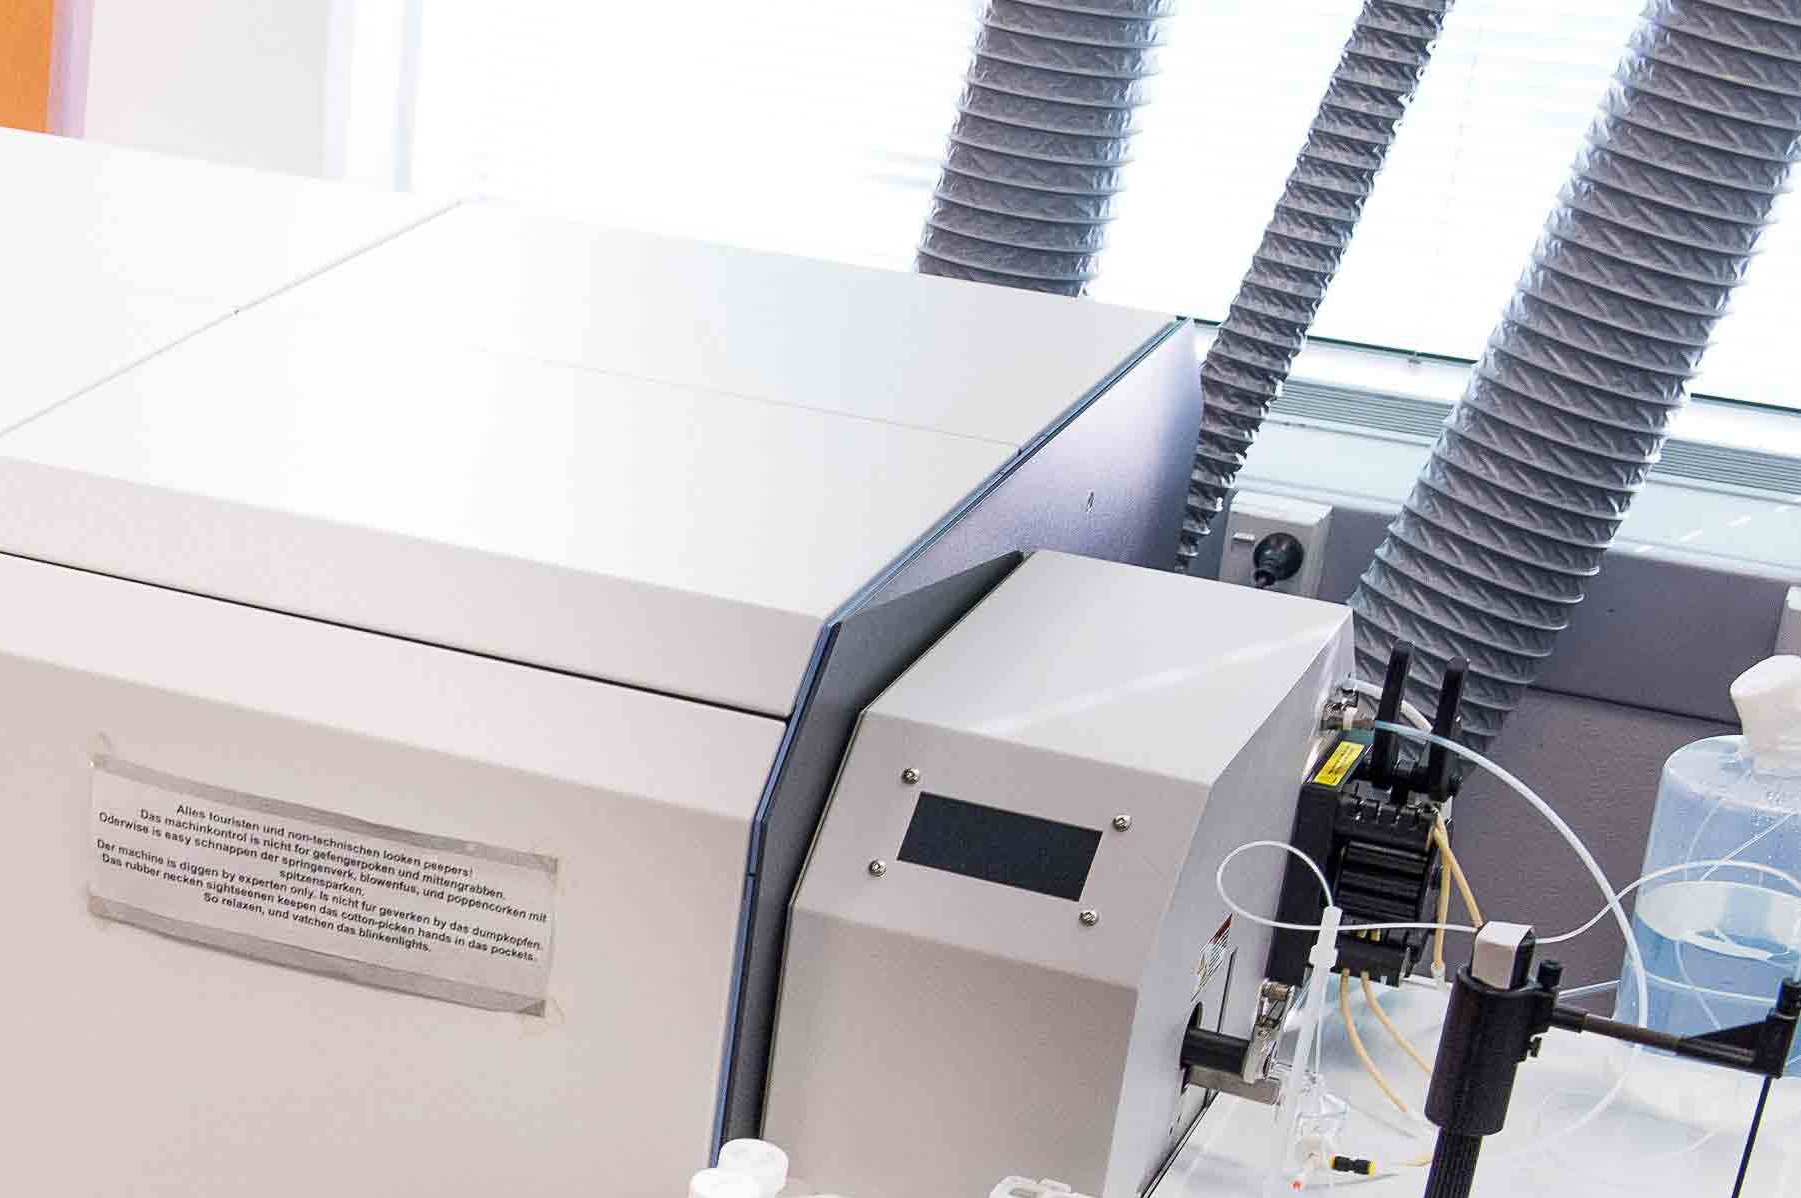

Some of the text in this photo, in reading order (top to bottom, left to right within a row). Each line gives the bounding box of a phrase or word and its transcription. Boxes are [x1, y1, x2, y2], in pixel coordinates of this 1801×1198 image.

[98, 811, 149, 834] Oderwise
[151, 827, 162, 838] is
[165, 831, 192, 846] easy
[194, 837, 258, 858] schnappen
[260, 851, 280, 863] der
[422, 888, 444, 900] und
[447, 894, 526, 919] poppencorken
[528, 911, 547, 923] mit
[140, 808, 162, 824] Das
[164, 817, 247, 843] machinkontrol
[250, 835, 261, 845] is
[263, 837, 292, 851] nicht
[294, 843, 310, 856] for
[398, 868, 420, 881] und
[422, 873, 507, 900] mittengrabben.
[176, 804, 206, 819] Alles
[208, 811, 260, 831] touristen
[263, 825, 285, 837] und
[287, 830, 381, 858] non-technischen
[382, 850, 421, 867] looken
[97, 839, 116, 851] Der
[118, 845, 164, 865] machine
[167, 857, 177, 869] is
[179, 861, 219, 877] diggen
[222, 869, 236, 882] by
[238, 875, 287, 893] experten
[319, 891, 329, 902] Is
[332, 895, 360, 910] nicht
[379, 906, 430, 926] geverken
[433, 915, 447, 930] by
[449, 921, 470, 934] das
[472, 927, 544, 951] dumpkopfen.
[102, 853, 123, 867] Das
[125, 860, 161, 878] rubber
[163, 870, 204, 888] necken
[277, 896, 317, 913] keepen
[319, 906, 338, 918] das
[341, 911, 415, 935] cotton-picken
[417, 927, 452, 944] hands
[455, 937, 465, 947] in
[468, 939, 488, 952] das
[203, 892, 432, 952] So relaxen, und vatchen das blinkenlights.
[279, 869, 365, 897] spitzensparken.
